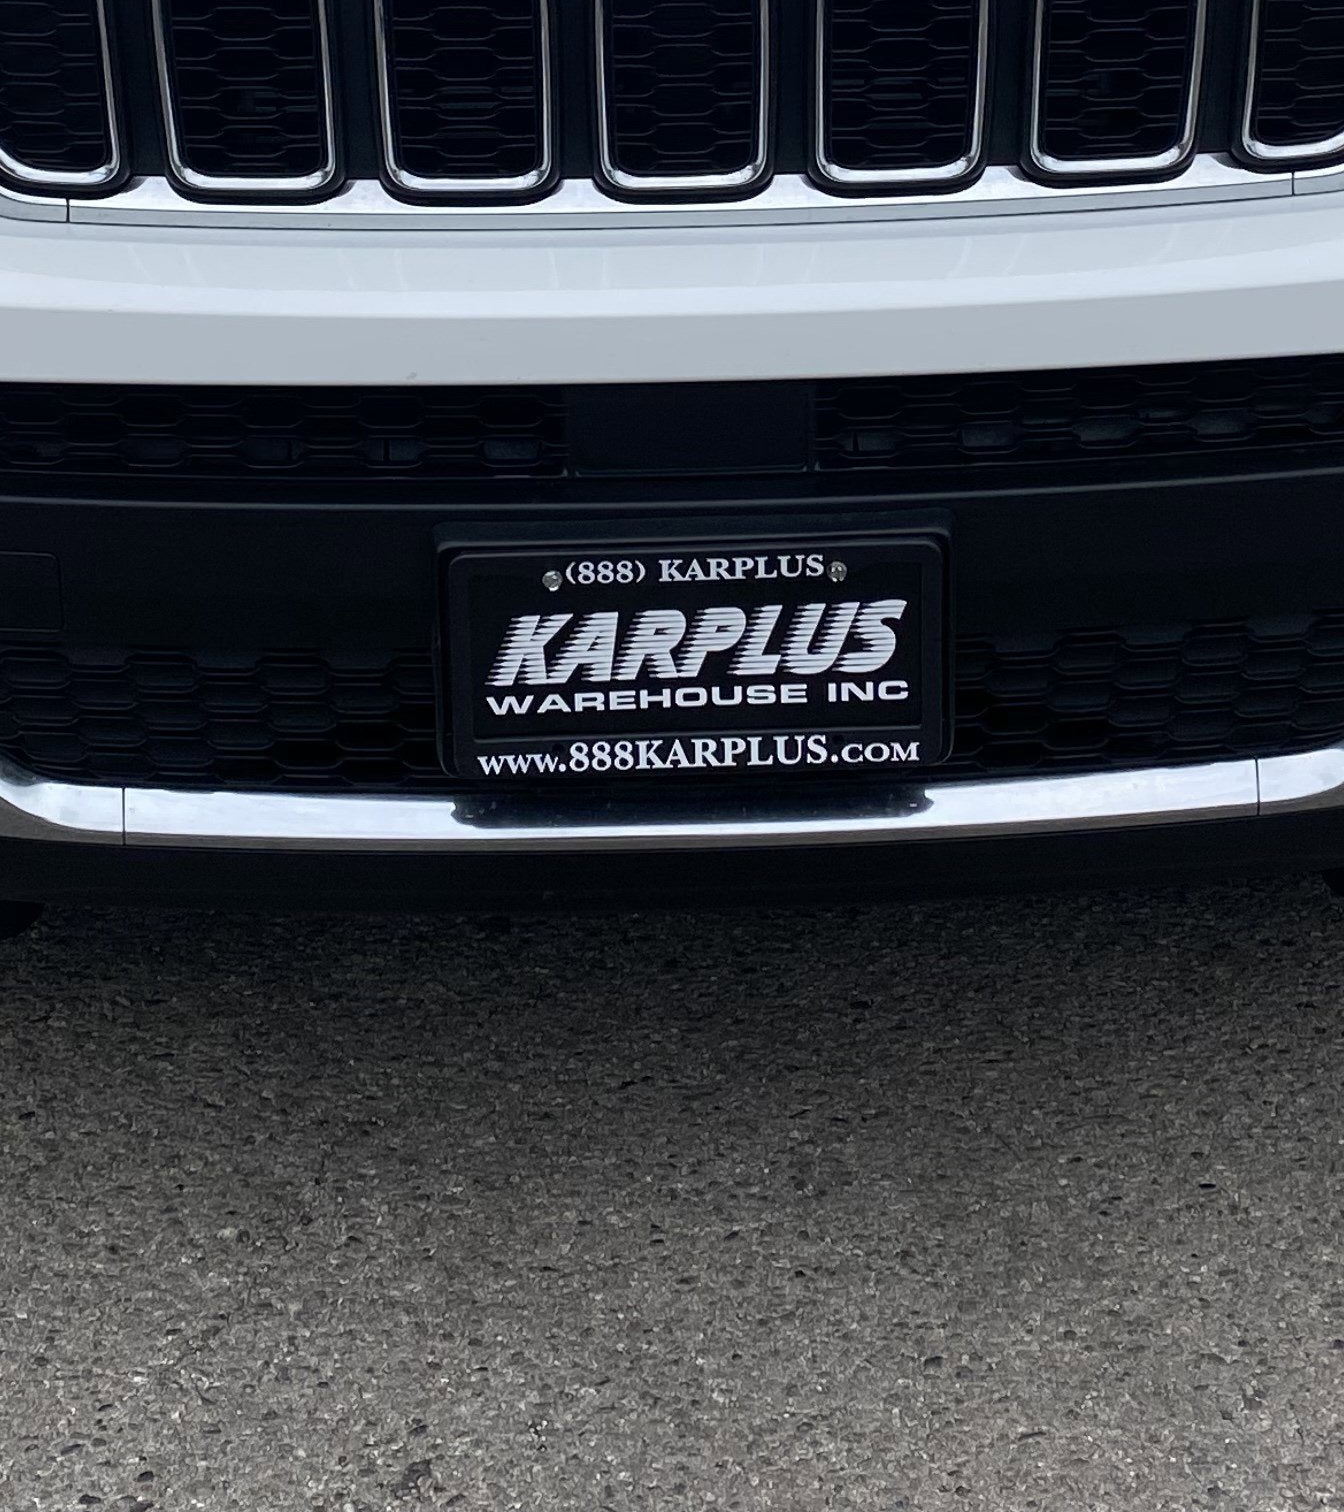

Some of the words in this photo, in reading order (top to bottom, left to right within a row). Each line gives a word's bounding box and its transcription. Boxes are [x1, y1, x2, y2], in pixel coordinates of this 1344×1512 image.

[565, 560, 646, 585] (888)
[658, 553, 825, 583] KARPLUS
[484, 599, 908, 687] KARPLUS
[485, 683, 809, 716] WAREHOUSE
[827, 680, 909, 704] INC
